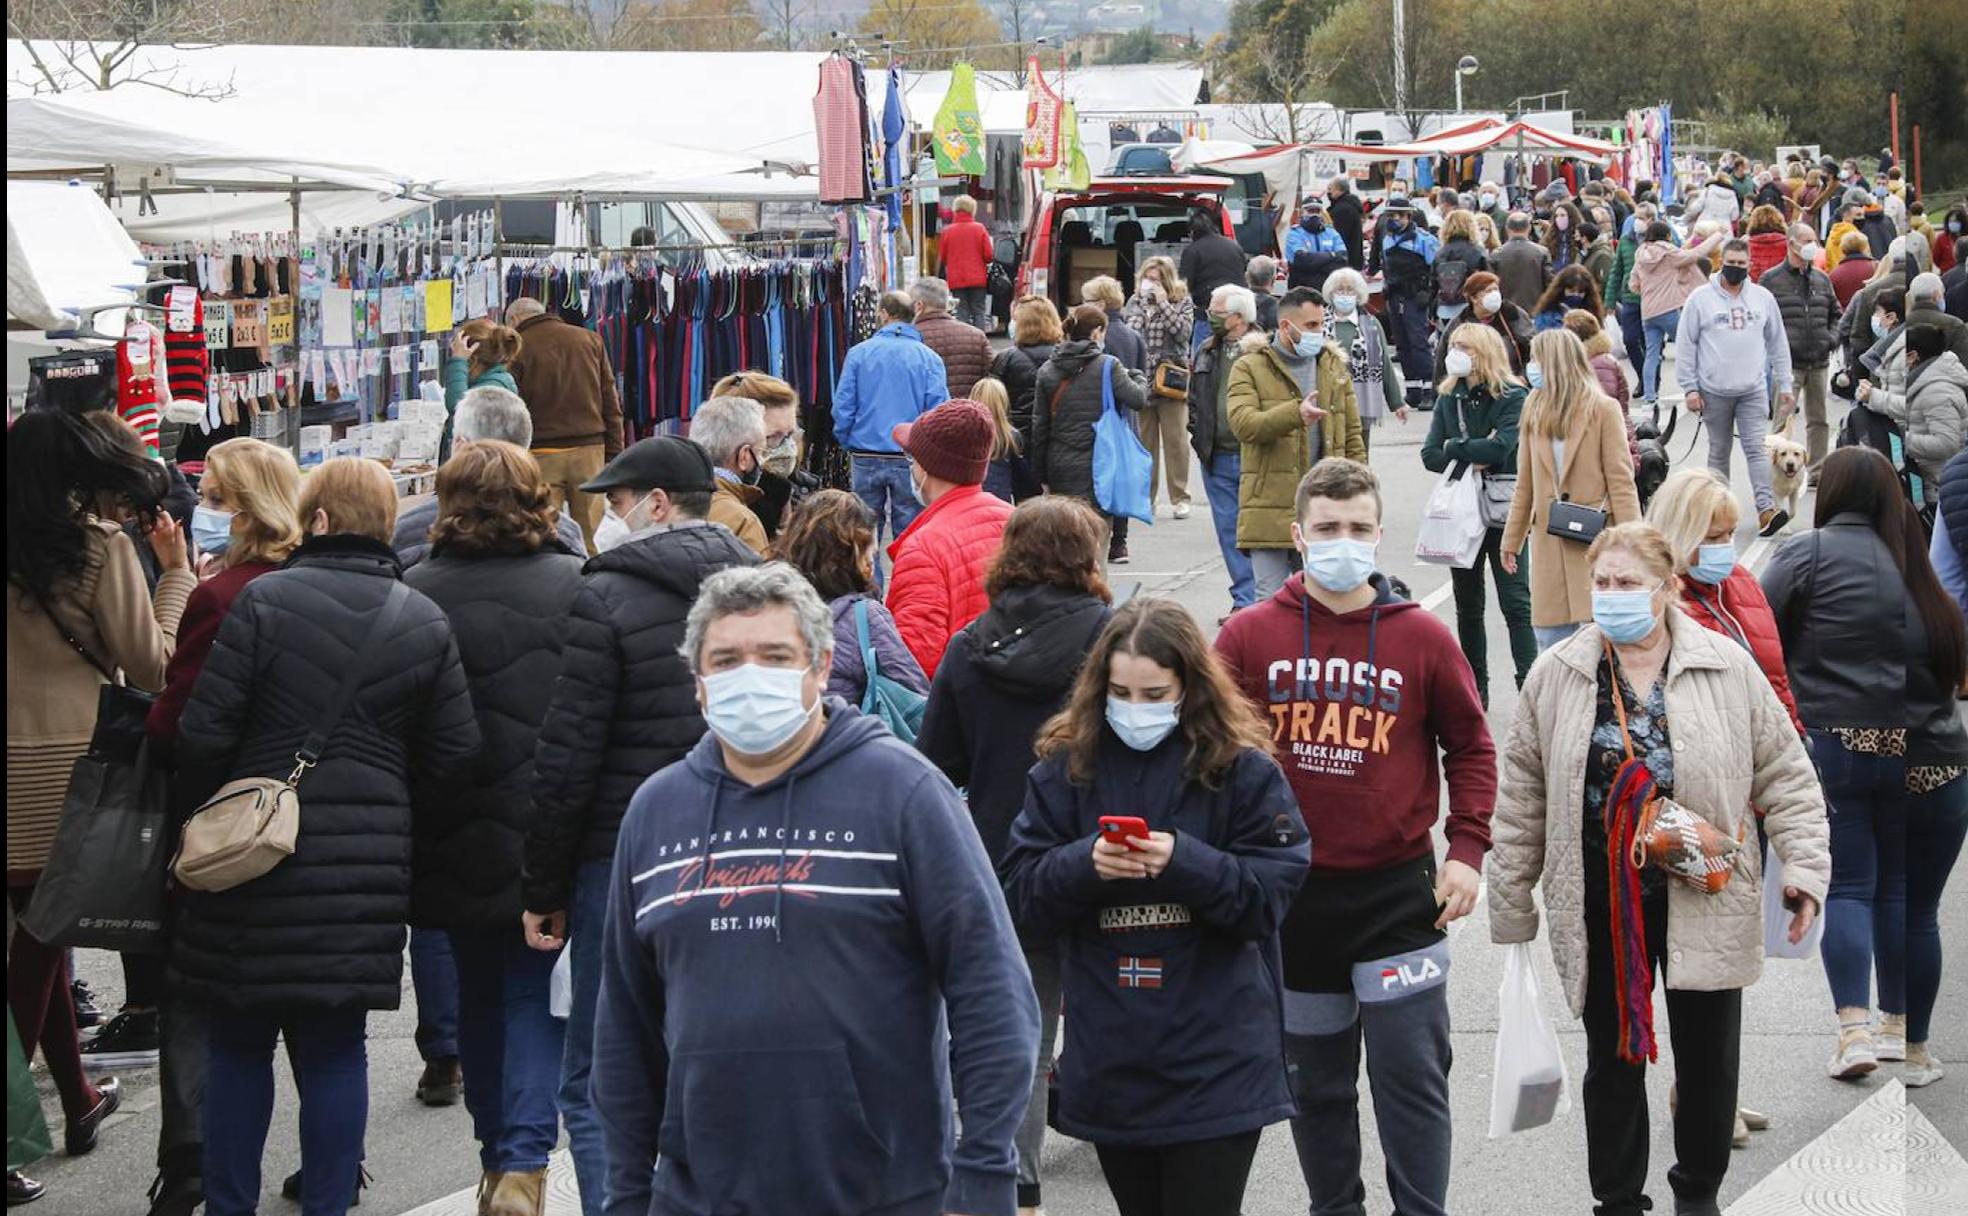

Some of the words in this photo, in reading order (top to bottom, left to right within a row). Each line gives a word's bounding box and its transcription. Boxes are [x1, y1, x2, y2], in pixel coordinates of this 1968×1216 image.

[1267, 657, 1403, 713] CROSS
[1269, 702, 1397, 754] TRACK
[1292, 742, 1328, 758] BLACK
[1329, 747, 1364, 763] LABEL
[659, 837, 699, 856] SAN
[710, 827, 854, 843] FRANCISCO
[78, 917, 129, 929] G-STAR
[710, 917, 742, 931] EST.
[1382, 958, 1441, 991] FILA
